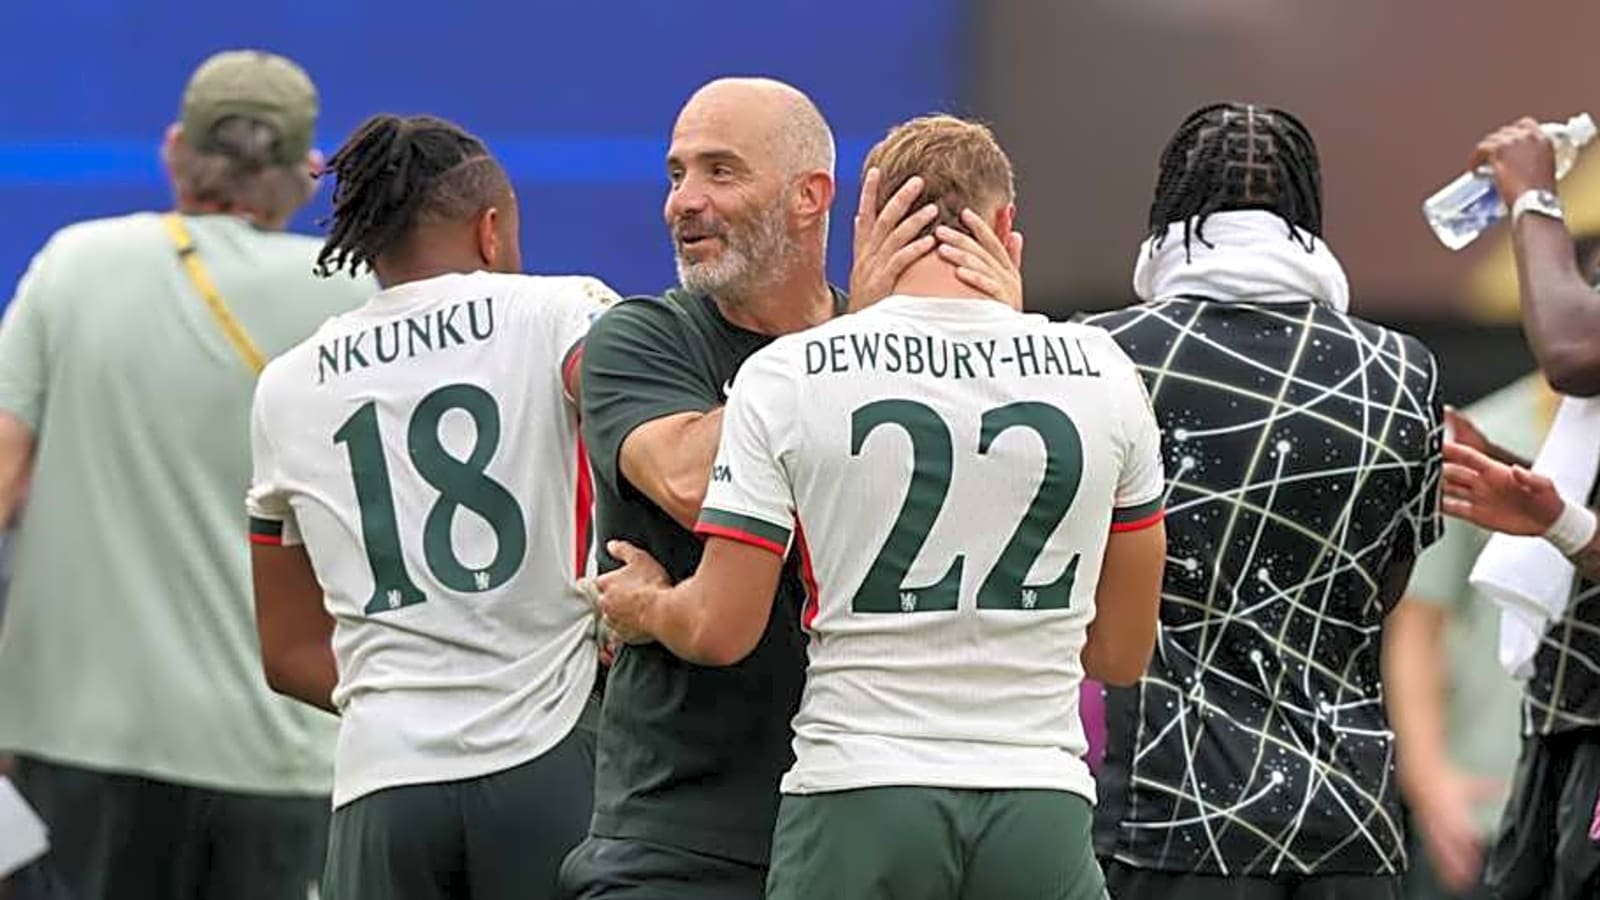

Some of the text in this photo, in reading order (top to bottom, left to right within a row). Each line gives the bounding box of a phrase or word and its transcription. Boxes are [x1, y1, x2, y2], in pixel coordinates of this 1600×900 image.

[318, 297, 494, 383] NKUNKU
[805, 333, 1101, 379] DEWSBURY-HALL
[333, 383, 527, 615] 18
[850, 398, 1083, 613] 22
